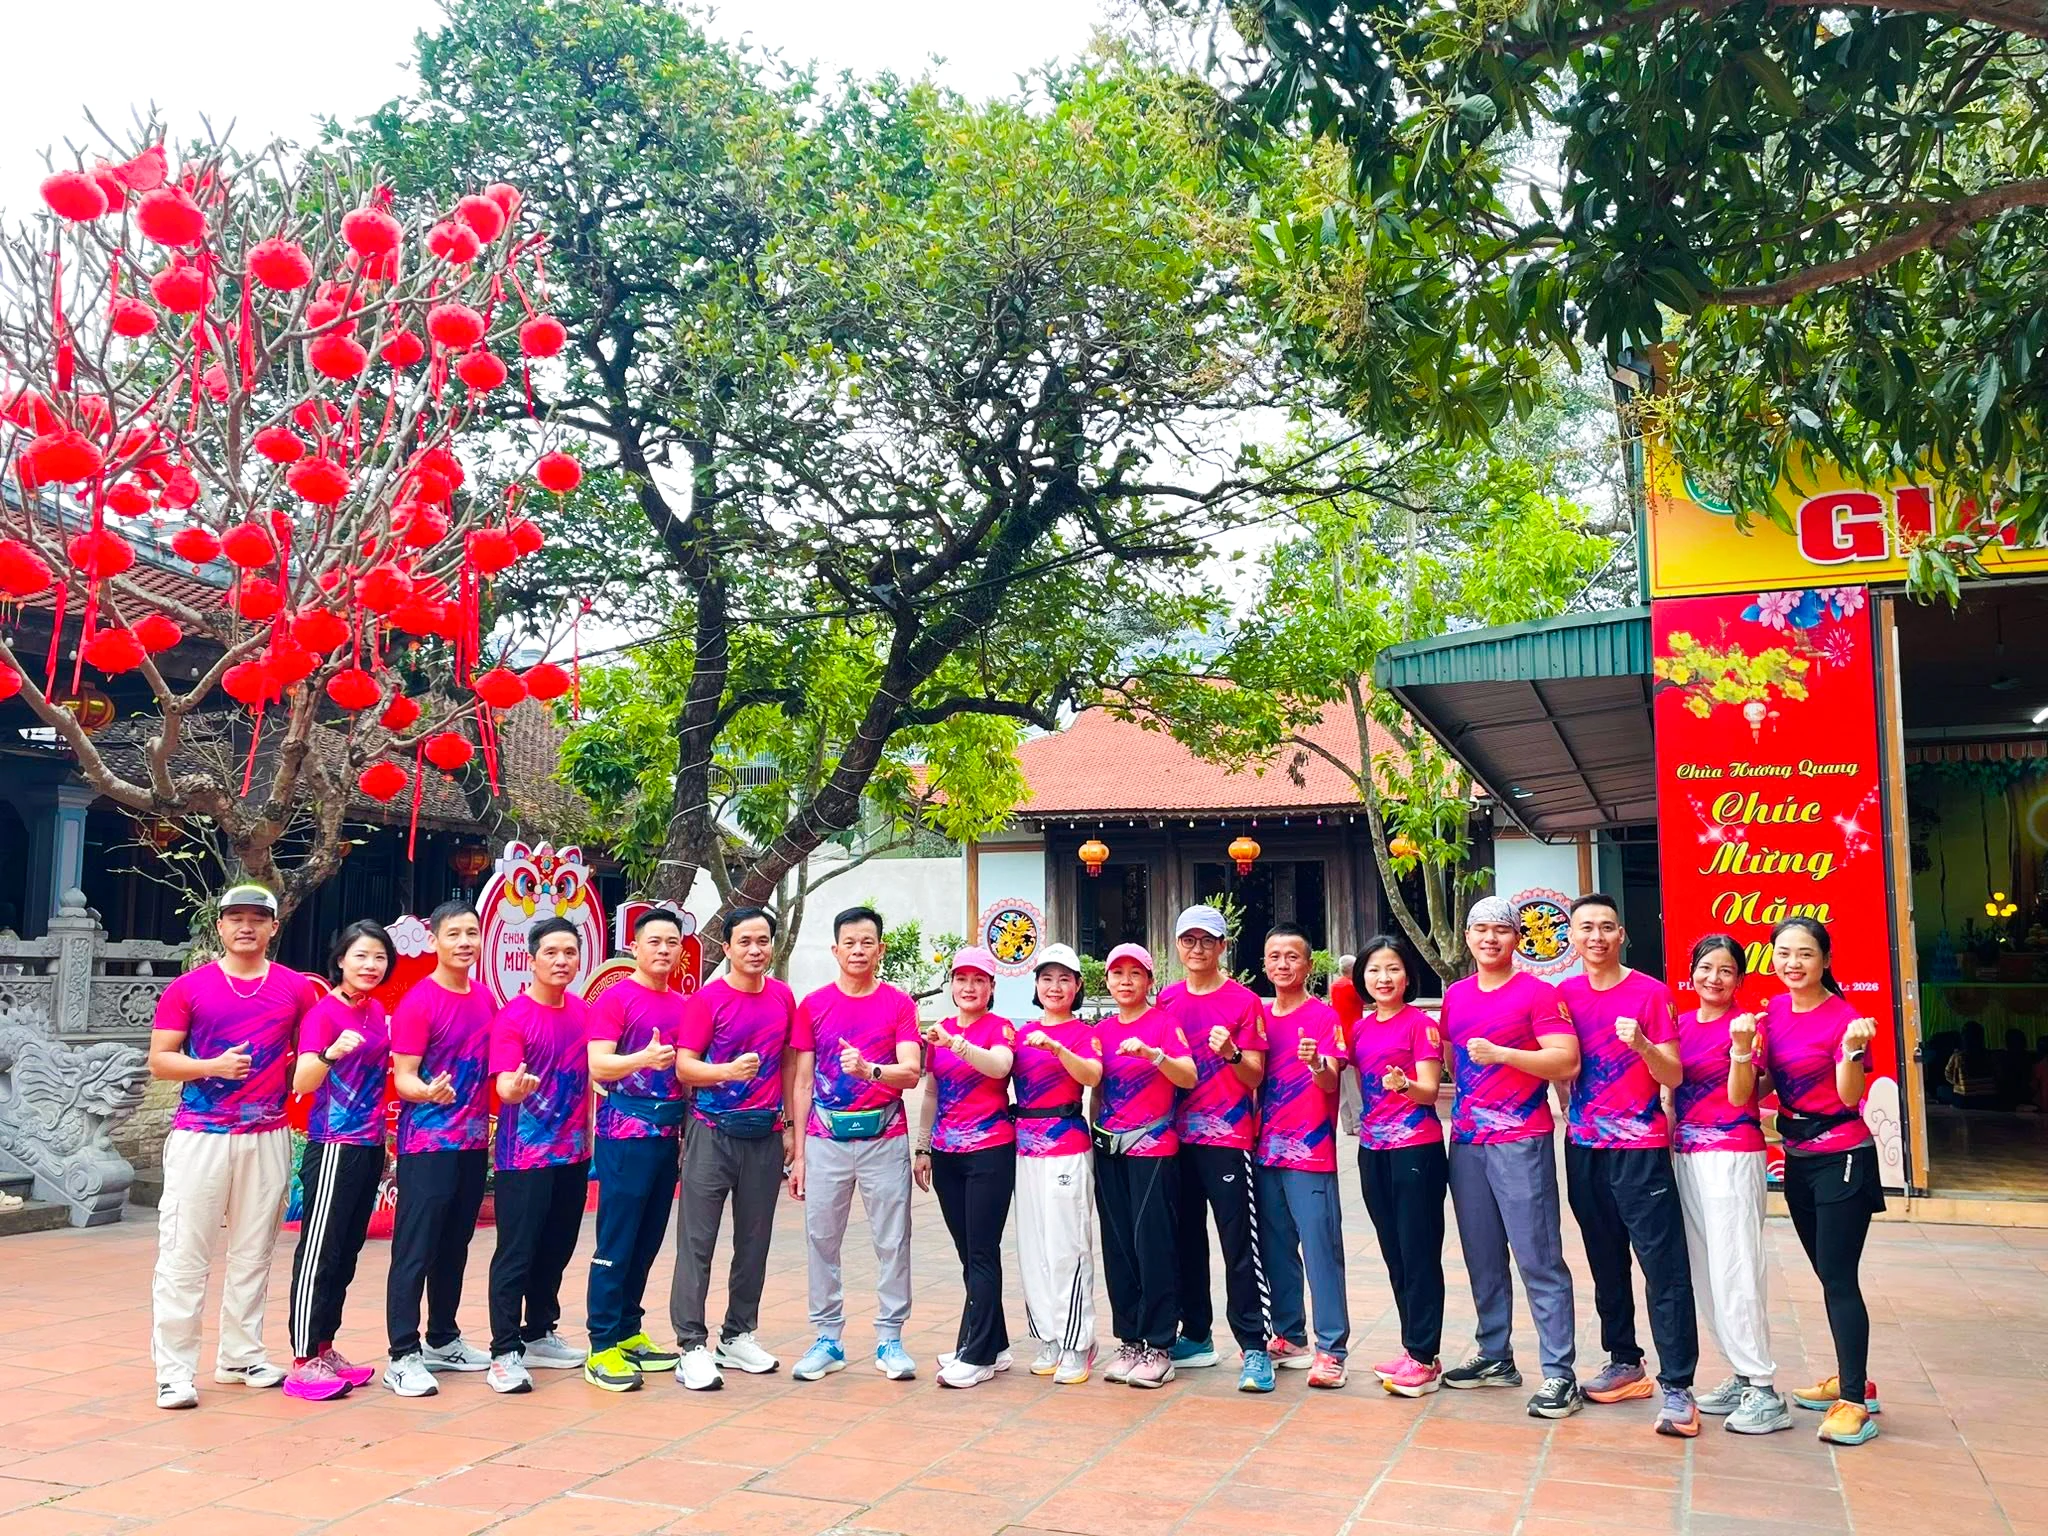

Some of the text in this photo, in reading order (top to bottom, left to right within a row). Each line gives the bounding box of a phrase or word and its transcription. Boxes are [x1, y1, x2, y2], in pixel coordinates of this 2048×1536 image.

[1676, 759, 1859, 779] Chùa Hương Quang
[1711, 791, 1823, 825] Chúc
[1698, 841, 1838, 881] Mừng
[1711, 891, 1834, 925] Năm
[1852, 981, 1880, 992] 2026
